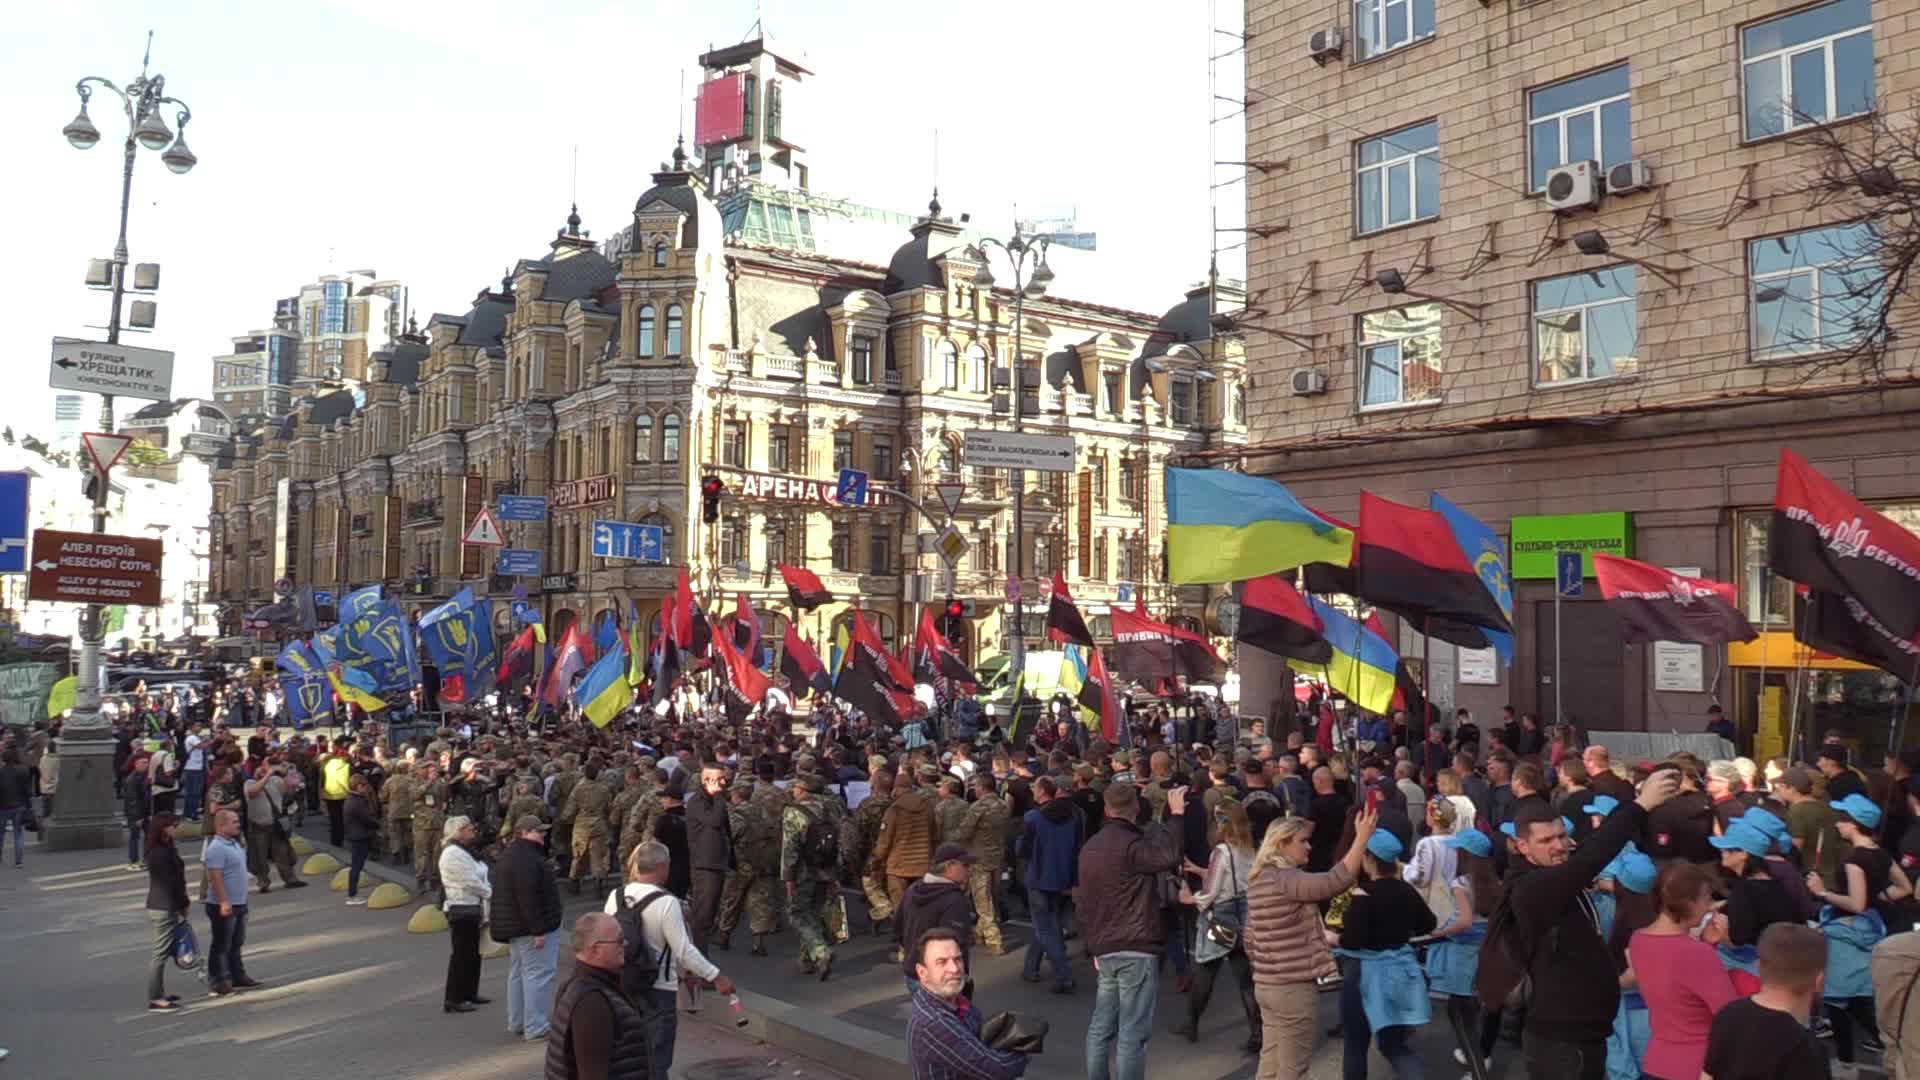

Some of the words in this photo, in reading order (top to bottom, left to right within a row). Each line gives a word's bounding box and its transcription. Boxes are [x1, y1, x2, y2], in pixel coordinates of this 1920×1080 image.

[79, 361, 153, 378] ХРЕЩАТИК
[743, 475, 820, 501] АРЕНА
[61, 542, 92, 554] АЛЕЯ
[96, 544, 136, 557] ГЕРОЇВ
[60, 556, 117, 570] НЕБЕСНОЇ
[120, 560, 152, 572] СОТНІ
[87, 577, 98, 585] OF
